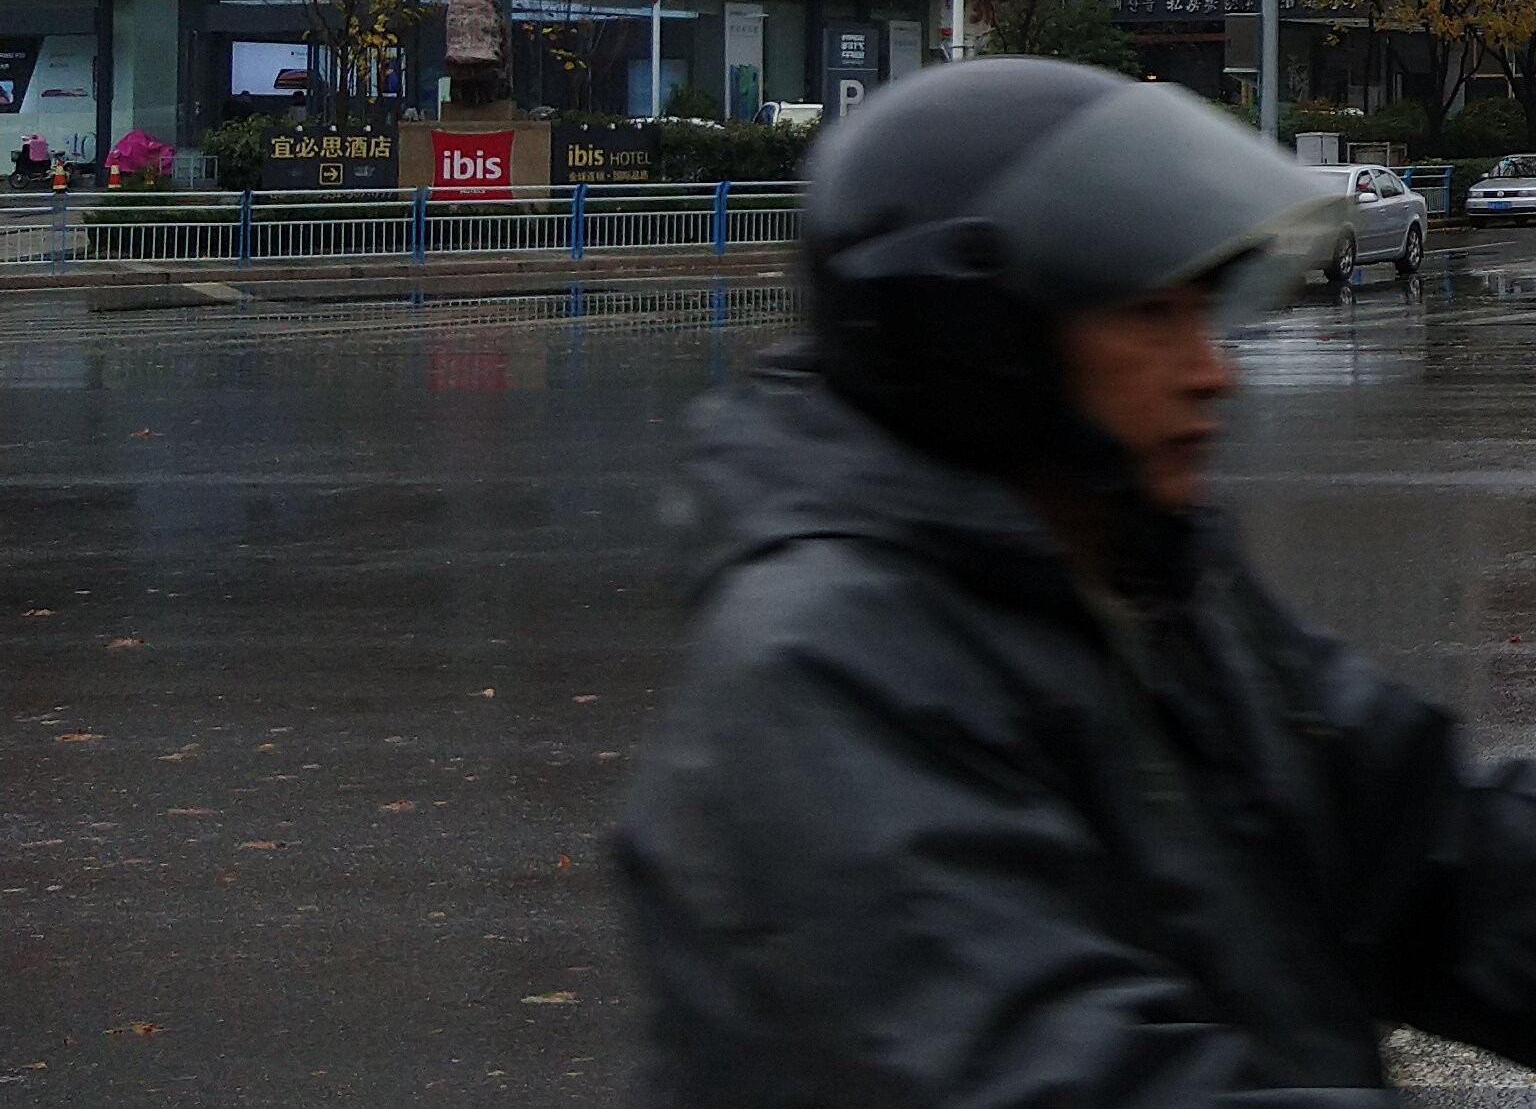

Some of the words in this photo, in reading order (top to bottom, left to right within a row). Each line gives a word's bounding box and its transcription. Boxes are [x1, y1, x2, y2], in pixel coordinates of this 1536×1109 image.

[839, 80, 865, 117] P
[270, 135, 391, 159] 宜必思酒店
[568, 144, 604, 166] ibis
[610, 151, 653, 165] HOTEL
[443, 150, 502, 180] ibis
